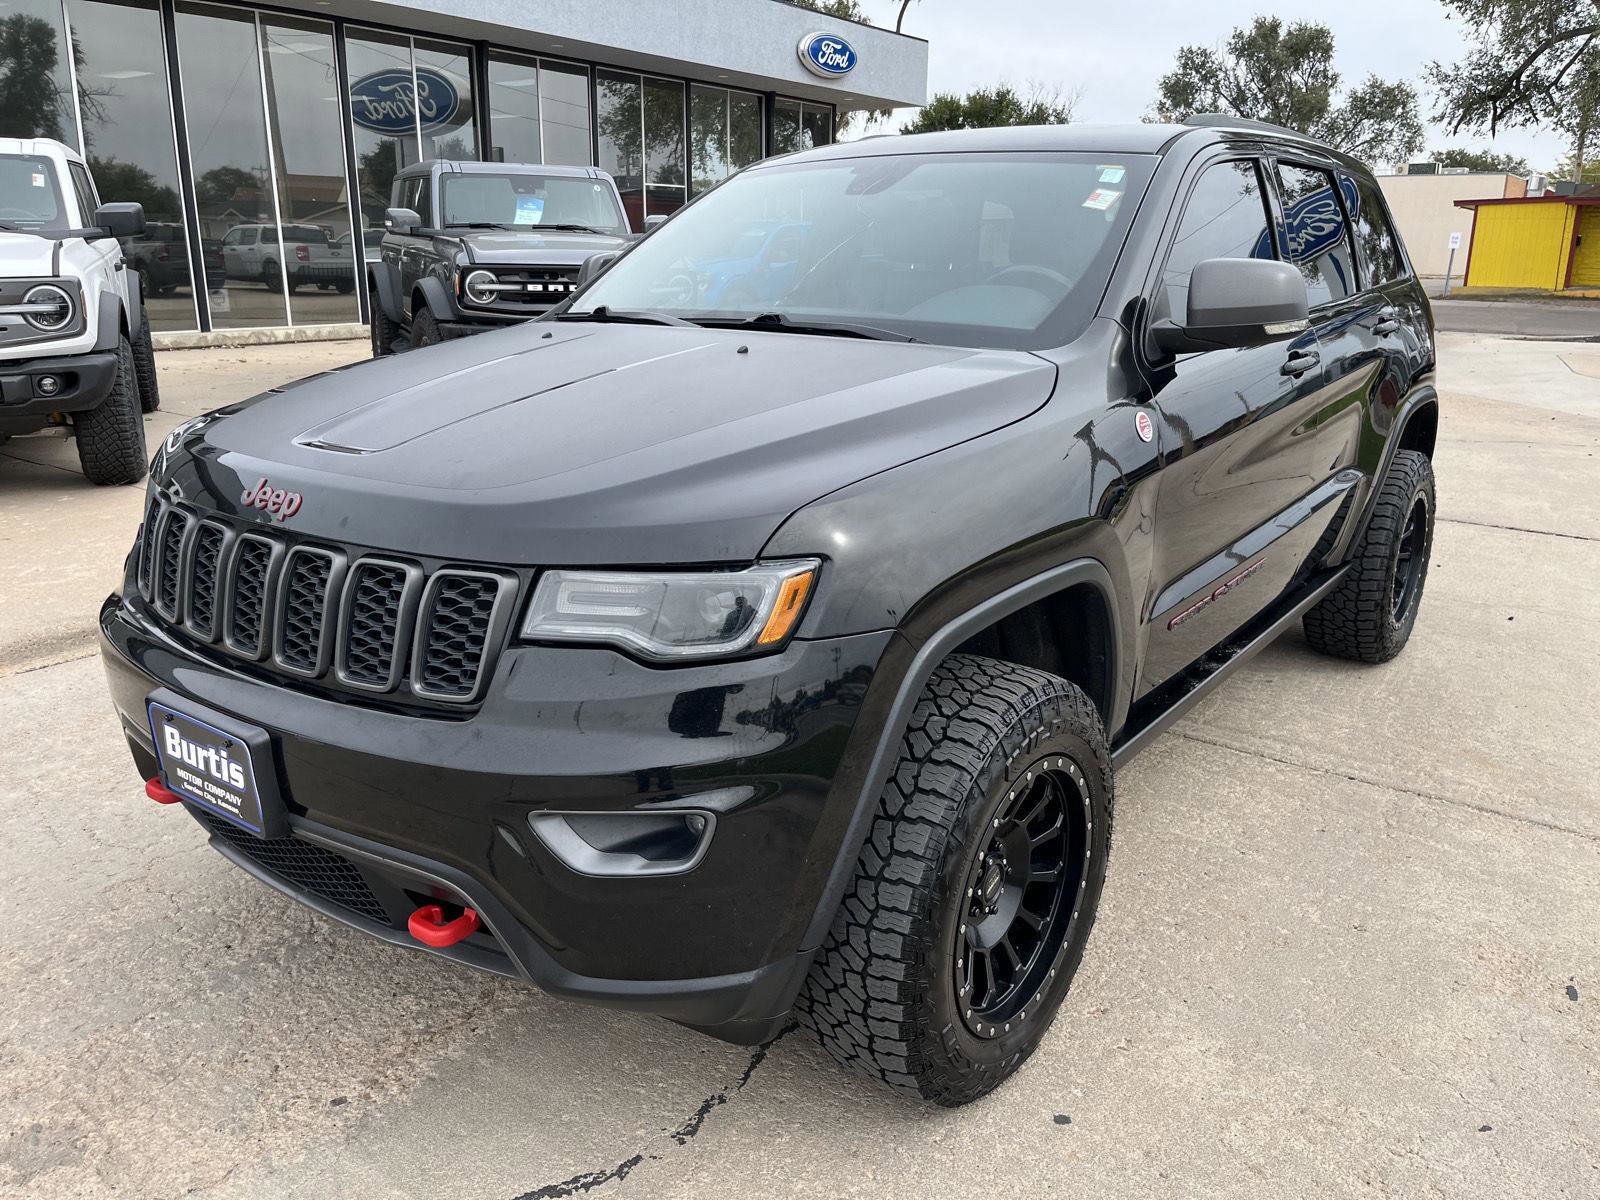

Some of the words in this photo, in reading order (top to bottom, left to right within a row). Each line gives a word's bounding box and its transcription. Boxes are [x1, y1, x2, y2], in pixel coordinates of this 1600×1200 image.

[818, 40, 850, 68] Ford
[240, 477, 303, 522] Jeep
[163, 724, 246, 790] Burtis
[176, 767, 203, 788] MOTOR
[204, 781, 243, 807] COMPANY
